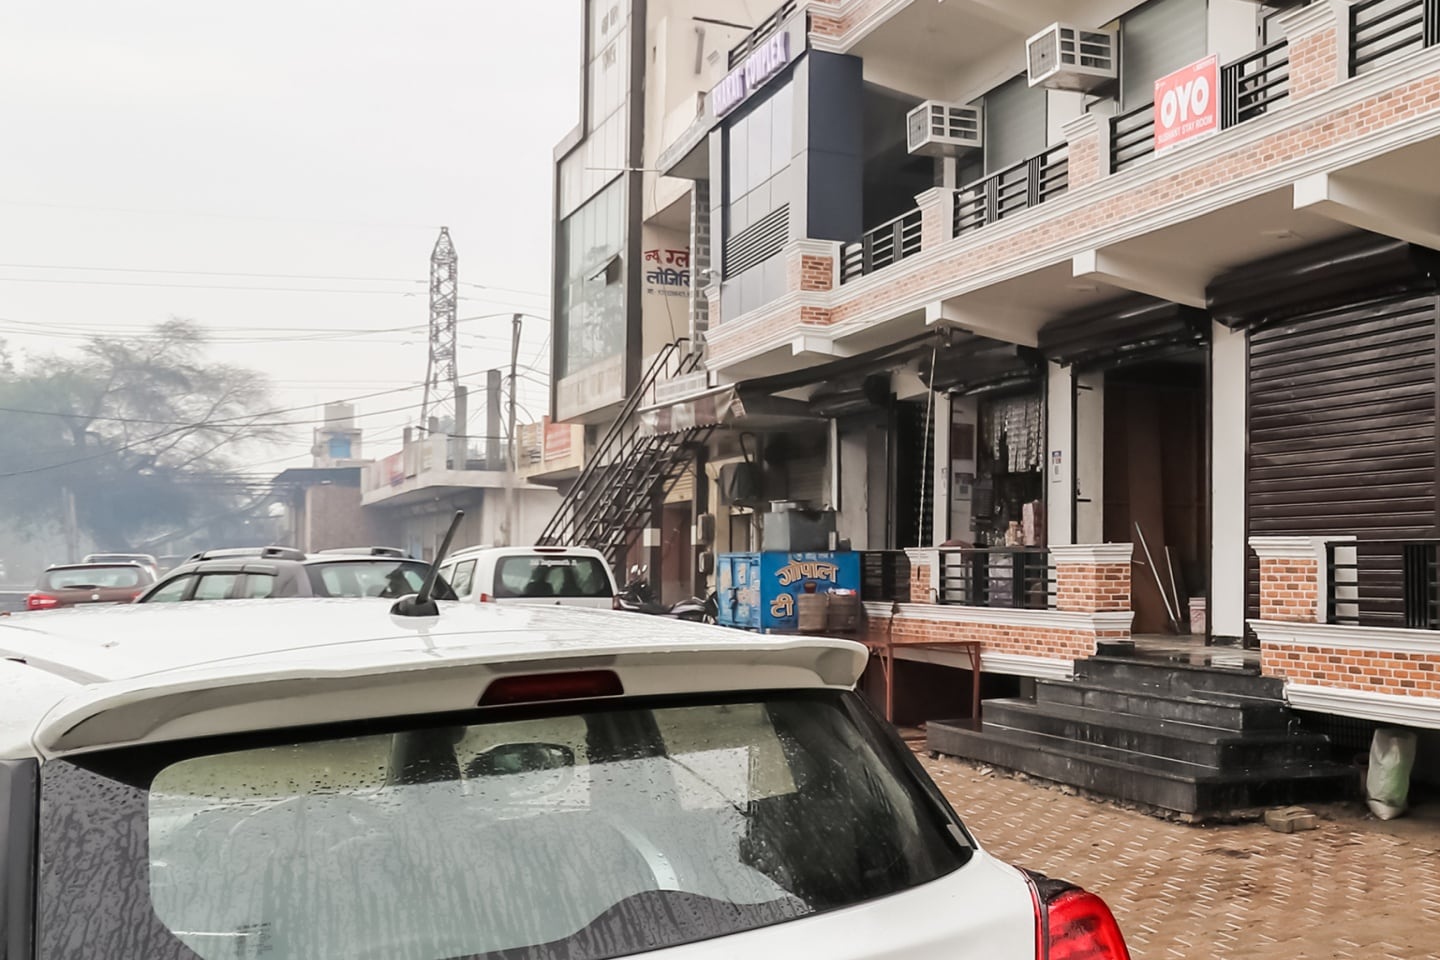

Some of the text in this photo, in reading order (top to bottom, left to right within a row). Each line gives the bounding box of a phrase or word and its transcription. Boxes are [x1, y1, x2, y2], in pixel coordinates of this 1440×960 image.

[1160, 75, 1209, 129] OYO
[774, 558, 839, 586] गोपाल
[770, 593, 794, 618] टी
